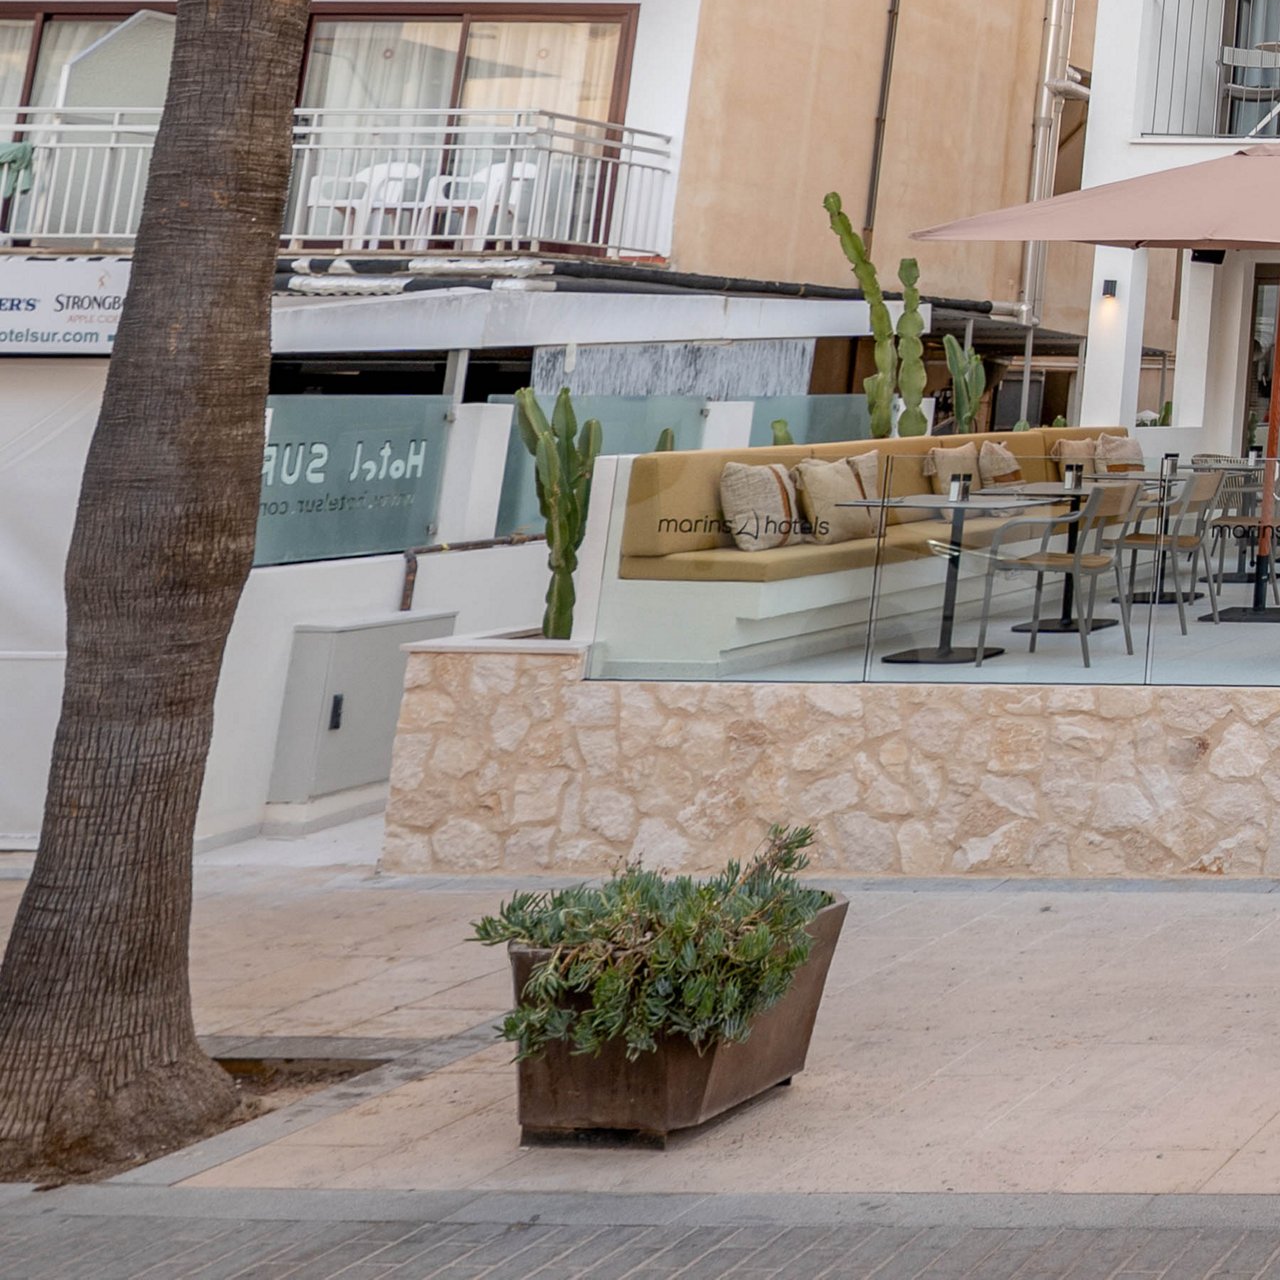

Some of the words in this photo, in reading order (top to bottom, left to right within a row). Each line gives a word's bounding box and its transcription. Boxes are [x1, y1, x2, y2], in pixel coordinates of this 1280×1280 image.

[54, 293, 124, 313] STRONGB
[657, 515, 733, 535] marins
[764, 516, 831, 536] hotels
